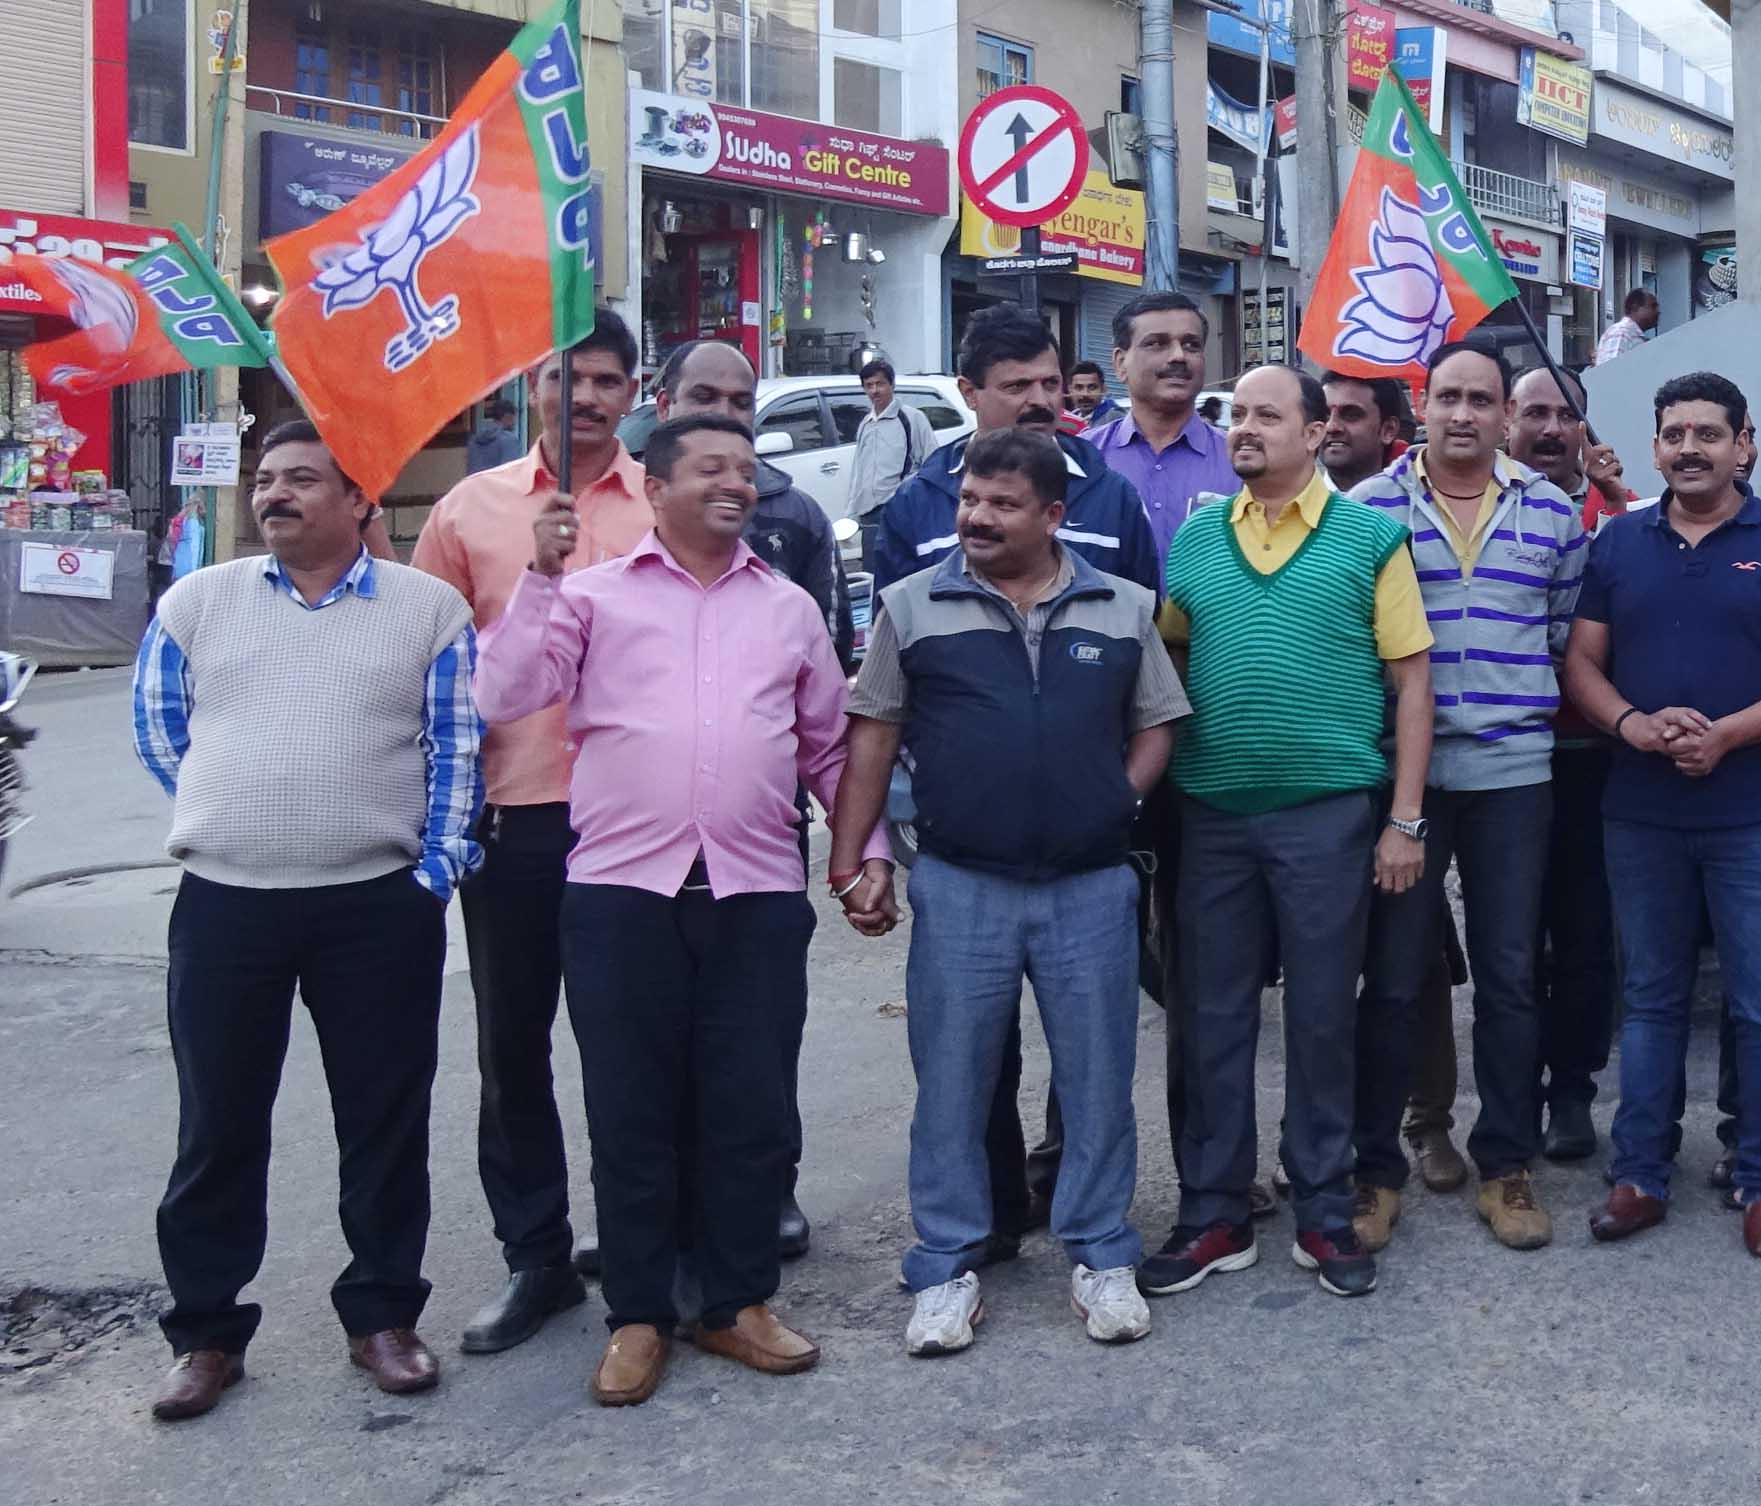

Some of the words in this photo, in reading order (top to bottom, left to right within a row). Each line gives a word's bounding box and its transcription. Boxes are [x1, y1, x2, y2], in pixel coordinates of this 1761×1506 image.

[726, 131, 791, 170] Sudha
[805, 151, 841, 176] Gift
[845, 158, 912, 188] Centre
[1040, 212, 1134, 246] yengar's
[1100, 248, 1136, 270] Bakery
